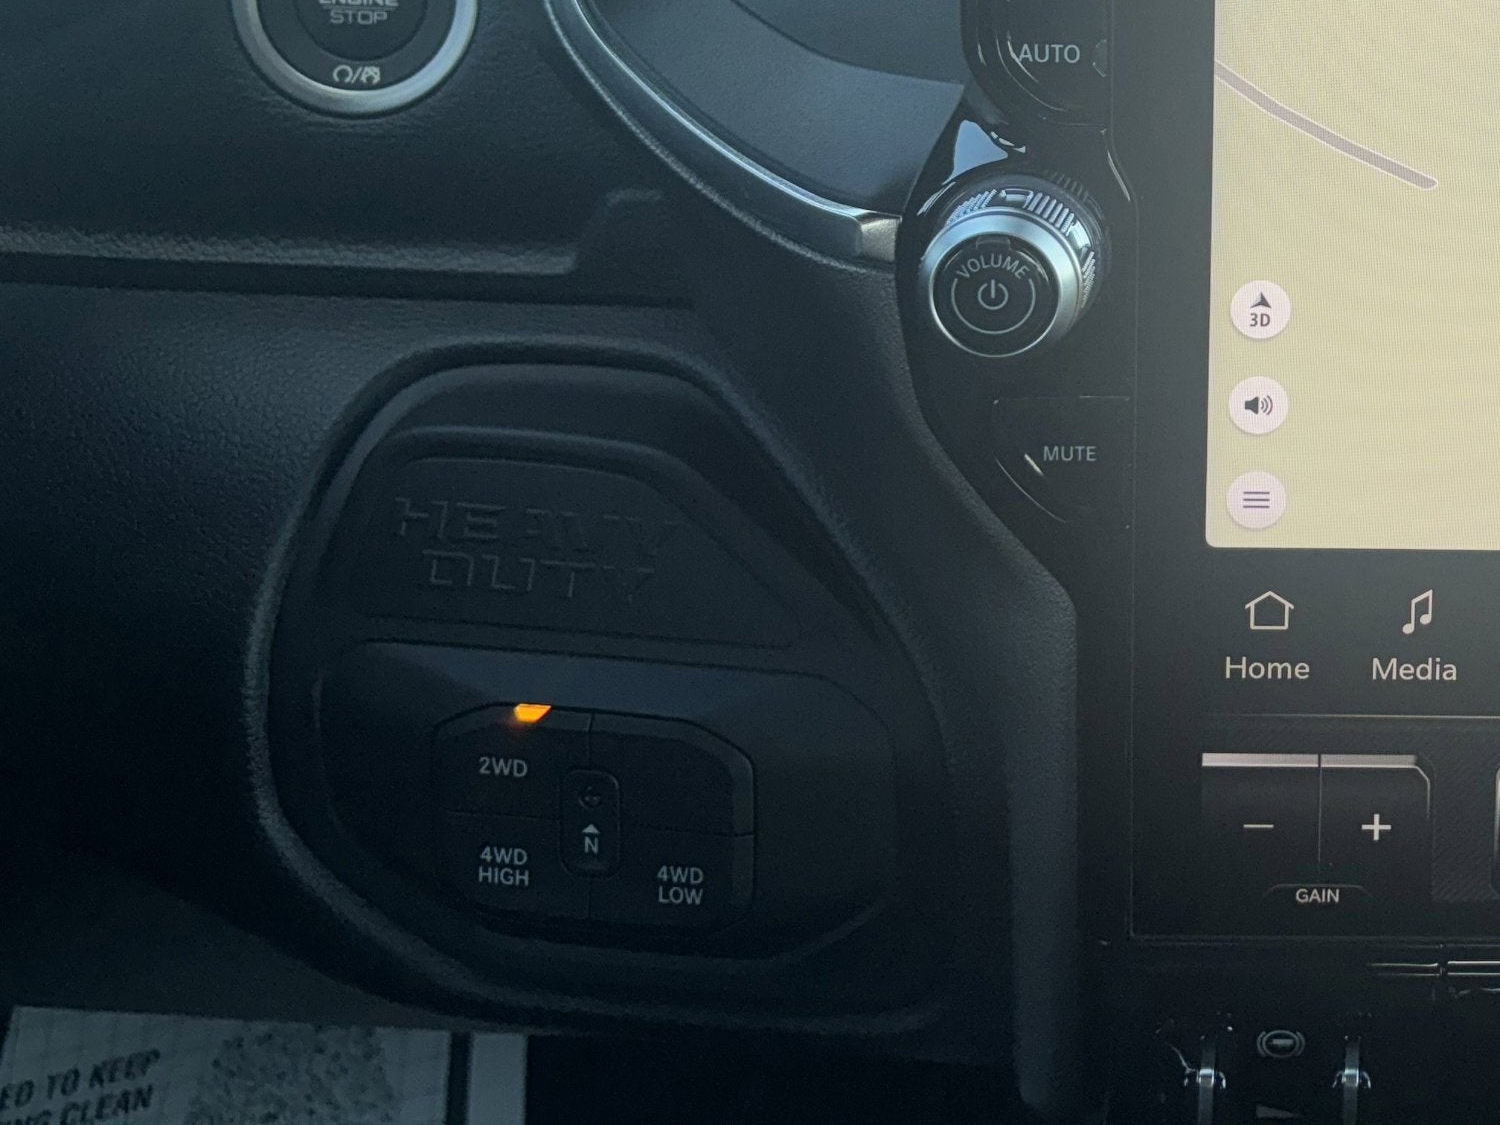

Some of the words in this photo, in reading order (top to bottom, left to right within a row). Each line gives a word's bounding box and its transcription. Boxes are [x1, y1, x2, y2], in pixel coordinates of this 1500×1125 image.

[329, 9, 388, 25] STOP
[1018, 44, 1081, 64] AUTO
[955, 254, 1031, 282] VOLUME
[1249, 312, 1271, 329] 3D
[1043, 445, 1097, 462] MUTE
[394, 496, 686, 557] HEAVY
[421, 549, 656, 605] DUTY
[1224, 656, 1311, 680] Home
[1371, 657, 1458, 681] Media
[479, 756, 529, 778] 2WD
[583, 835, 599, 854] N
[479, 845, 529, 866] 4WD
[477, 865, 530, 887] HIGH
[656, 864, 705, 885] 4WD
[657, 885, 704, 905] LOW
[1295, 887, 1341, 904] GAIN
[47, 1066, 80, 1101] TO
